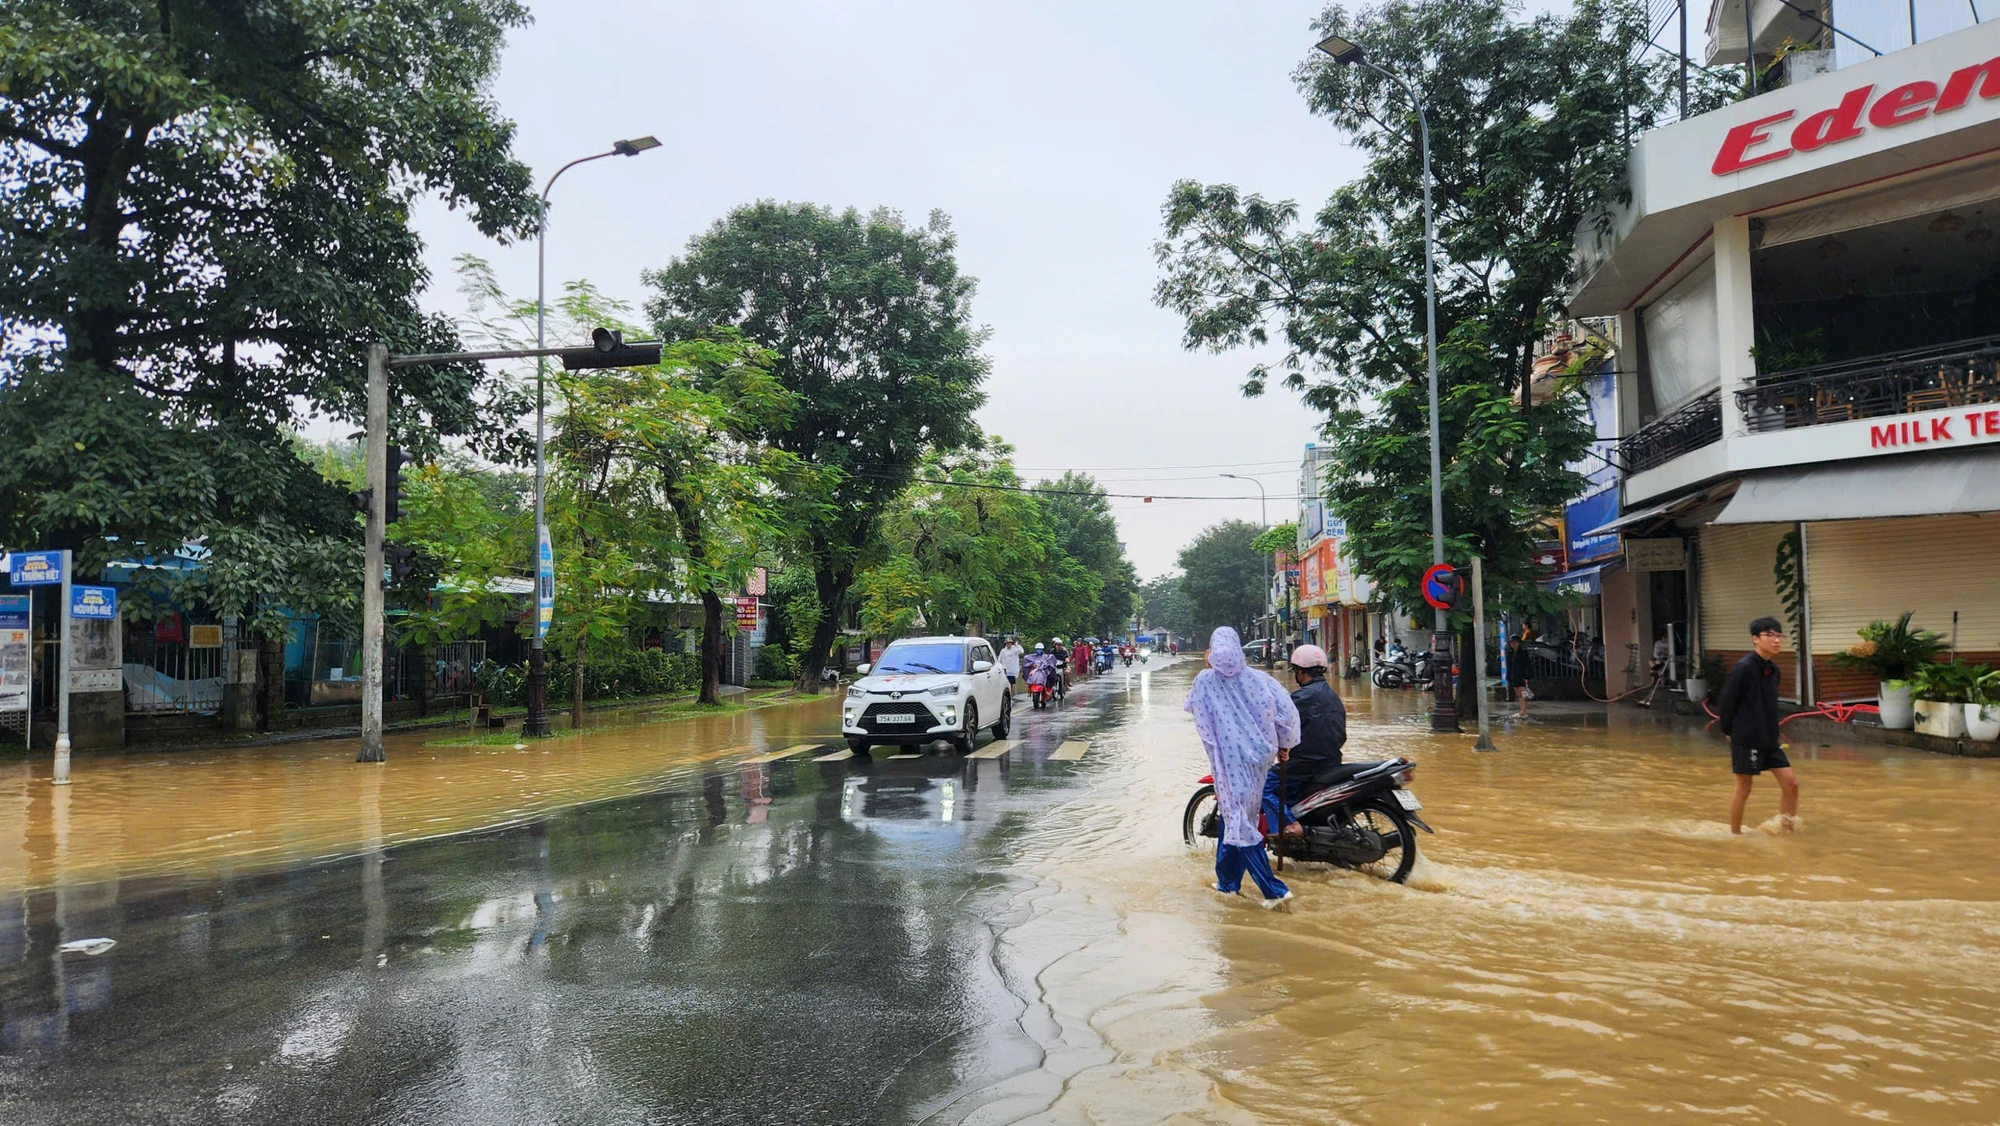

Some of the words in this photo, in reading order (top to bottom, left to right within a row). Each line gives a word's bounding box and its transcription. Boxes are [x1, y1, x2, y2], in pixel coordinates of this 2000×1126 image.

[1711, 56, 2000, 176] Eden
[1870, 416, 1953, 448] MILK
[1964, 410, 2000, 437] TE
